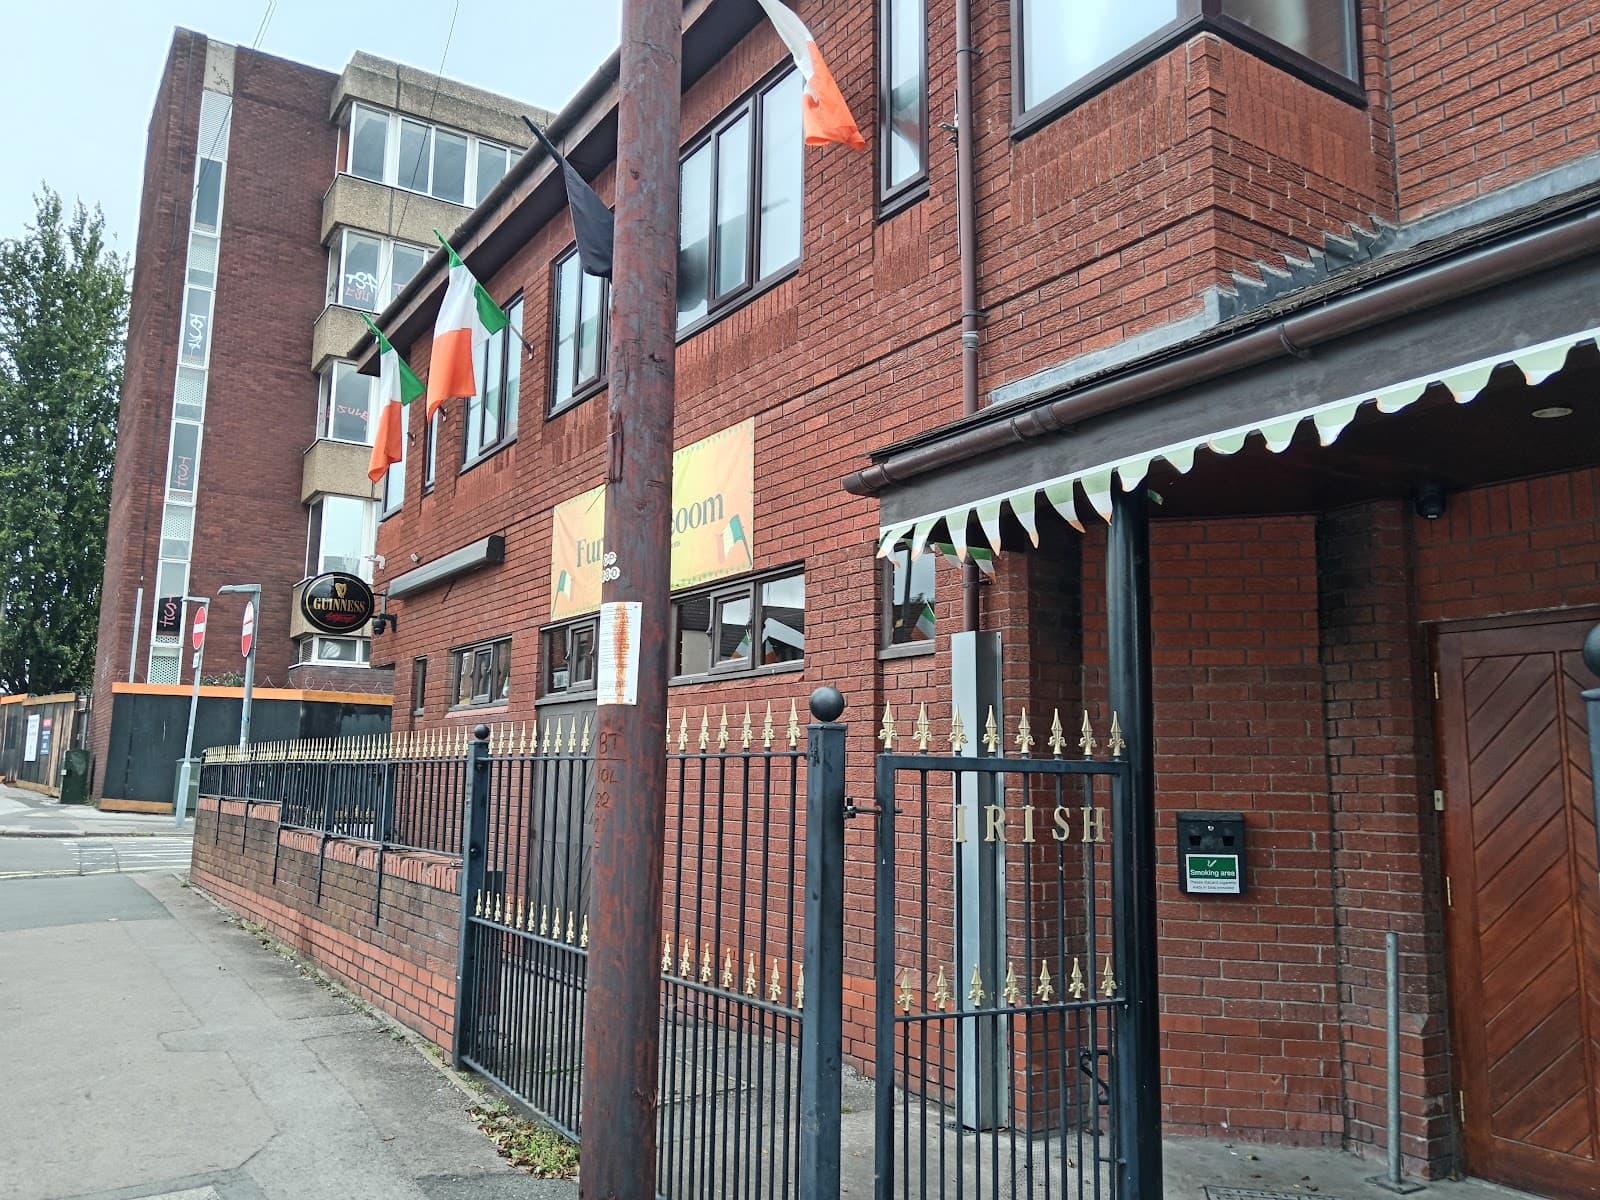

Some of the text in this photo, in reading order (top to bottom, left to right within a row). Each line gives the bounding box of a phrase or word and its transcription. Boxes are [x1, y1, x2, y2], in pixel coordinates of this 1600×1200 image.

[671, 494, 724, 534] oom
[313, 597, 366, 613] GUINNESS
[954, 803, 1106, 843] IRISH
[1190, 869, 1220, 878] Smoking
